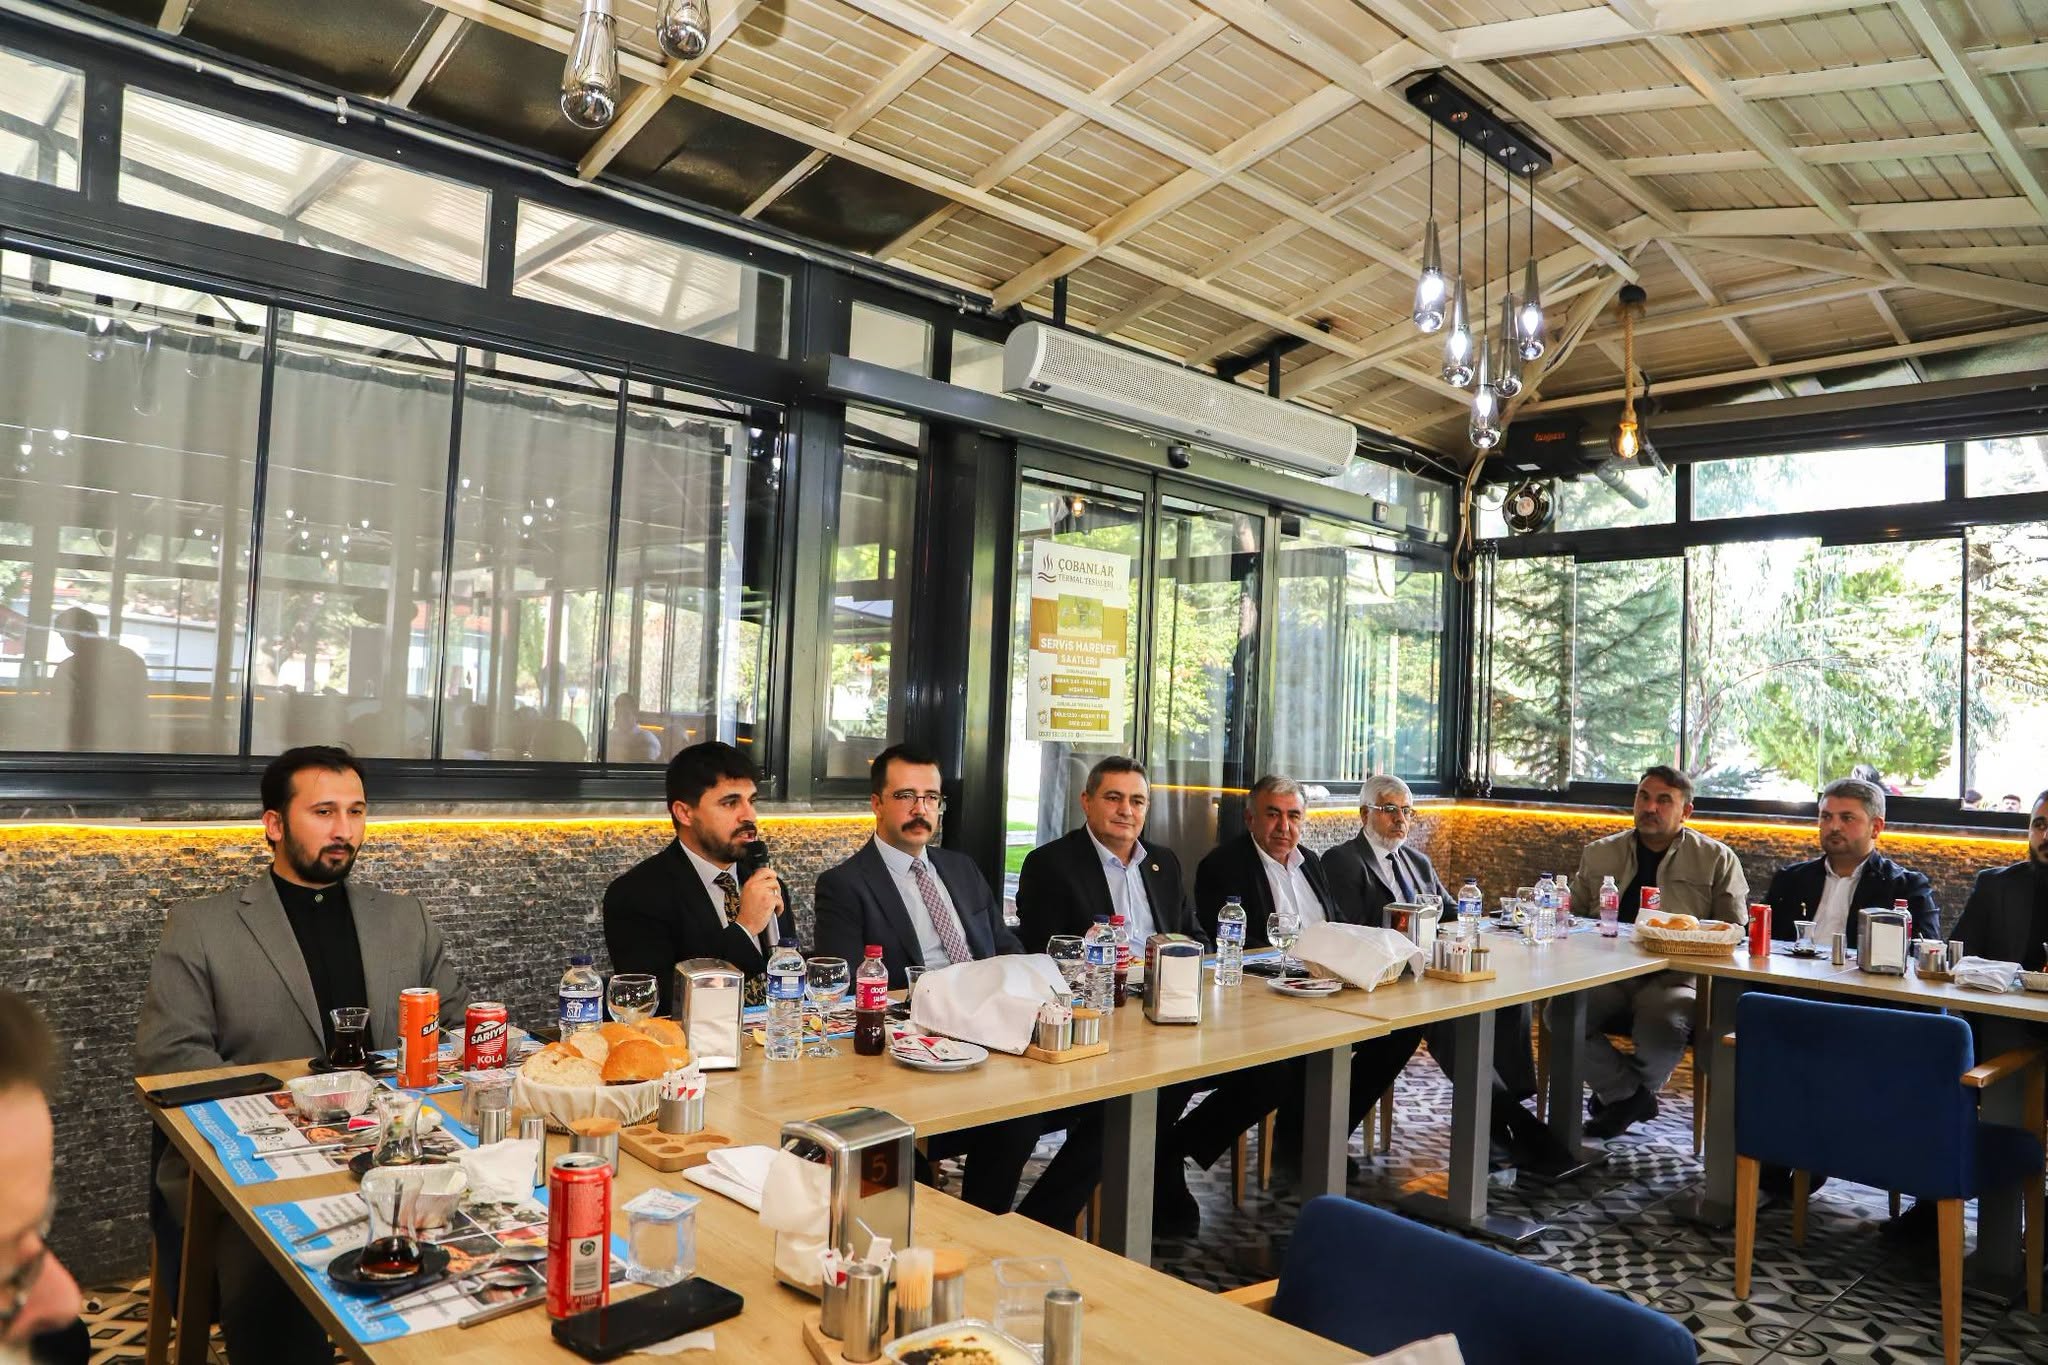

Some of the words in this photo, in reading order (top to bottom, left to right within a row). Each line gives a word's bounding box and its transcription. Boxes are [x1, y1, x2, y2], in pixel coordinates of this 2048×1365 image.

[1058, 558, 1114, 577] ÇOBANLAR
[1058, 573, 1083, 584] TERMAL
[1040, 637, 1074, 651] SERVİS
[1075, 641, 1118, 655] HAREKET
[477, 1054, 503, 1064] KOLA
[871, 1152, 888, 1183] 5
